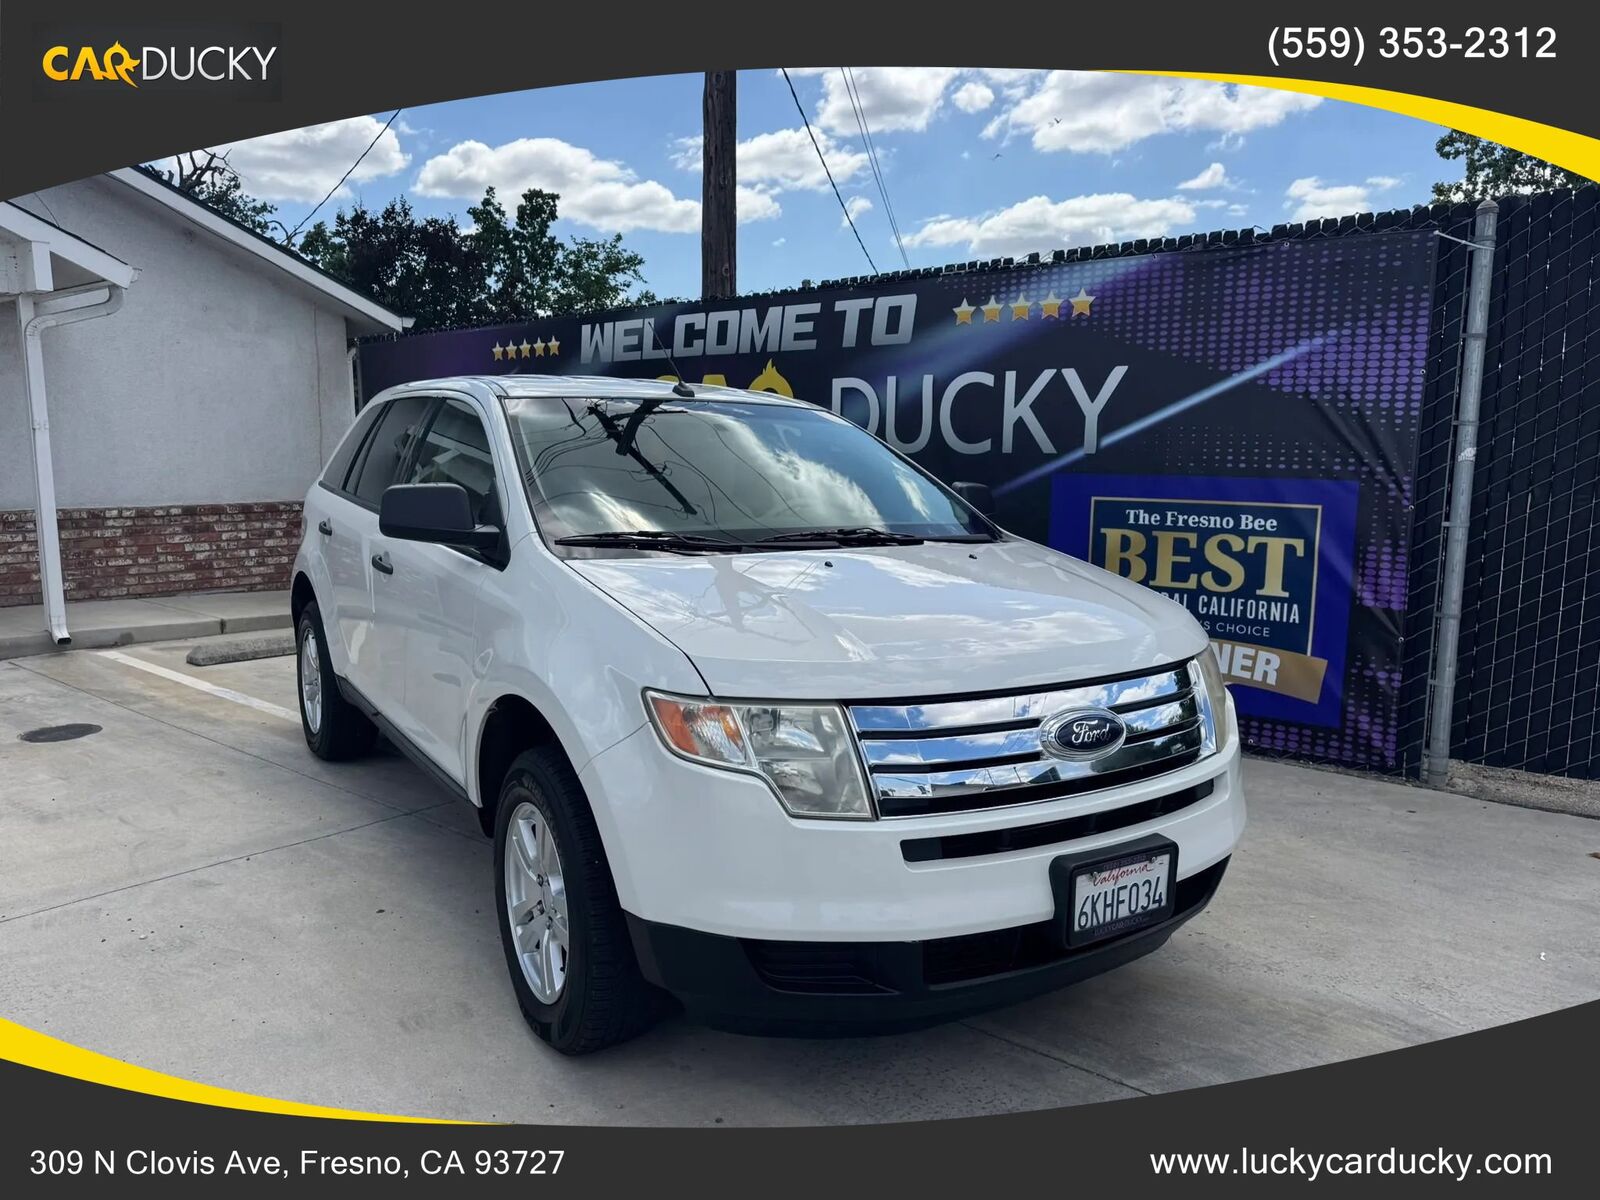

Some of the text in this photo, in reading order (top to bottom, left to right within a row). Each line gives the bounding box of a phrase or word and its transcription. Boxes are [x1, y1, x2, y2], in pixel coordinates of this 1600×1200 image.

[580, 293, 917, 364] WELCOME TO
[831, 365, 1129, 454] DUCKY
[1126, 509, 1278, 531] The Fresno Bee
[1100, 528, 1305, 598] BEST
[1198, 595, 1300, 624] CALIFORNIA
[1216, 622, 1271, 637] CHOICE
[1211, 641, 1281, 686] NER
[1072, 719, 1112, 745] Ford
[1093, 863, 1154, 886] California
[1077, 876, 1164, 929] 6KHF034
